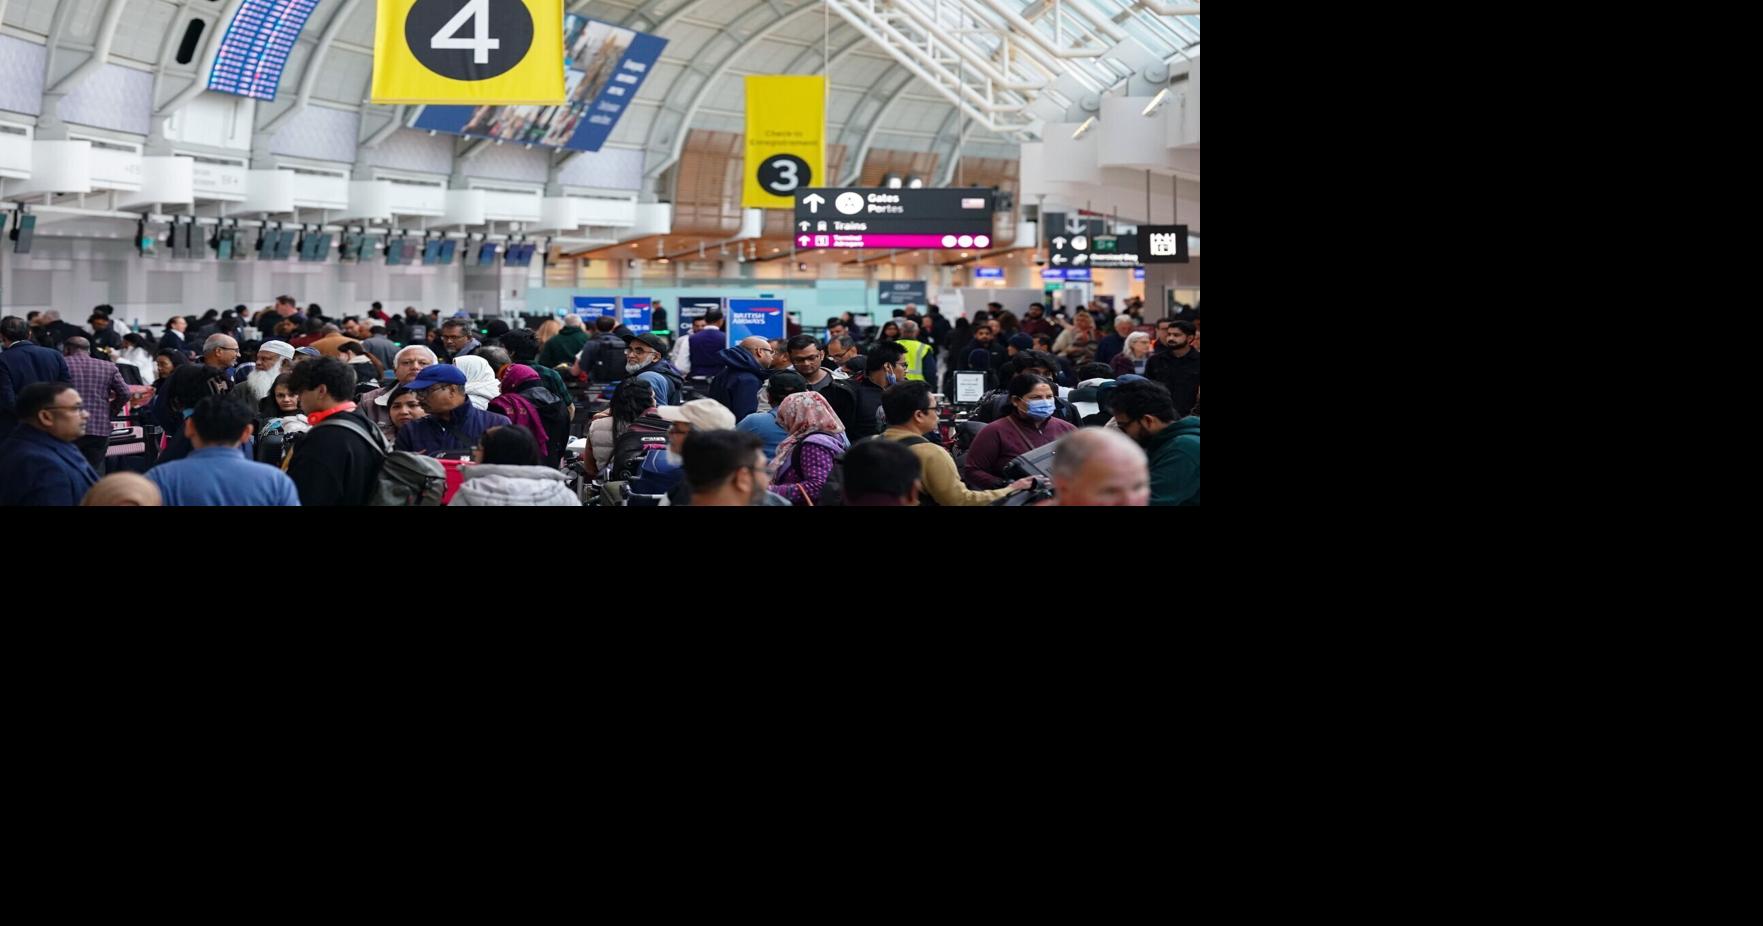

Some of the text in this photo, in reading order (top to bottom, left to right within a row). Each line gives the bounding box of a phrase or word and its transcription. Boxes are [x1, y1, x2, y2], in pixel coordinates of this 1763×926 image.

[431, 0, 499, 63] 4
[770, 159, 799, 191] 3
[867, 193, 900, 203] Gates
[867, 204, 904, 213] Portes
[833, 221, 868, 230] Trains
